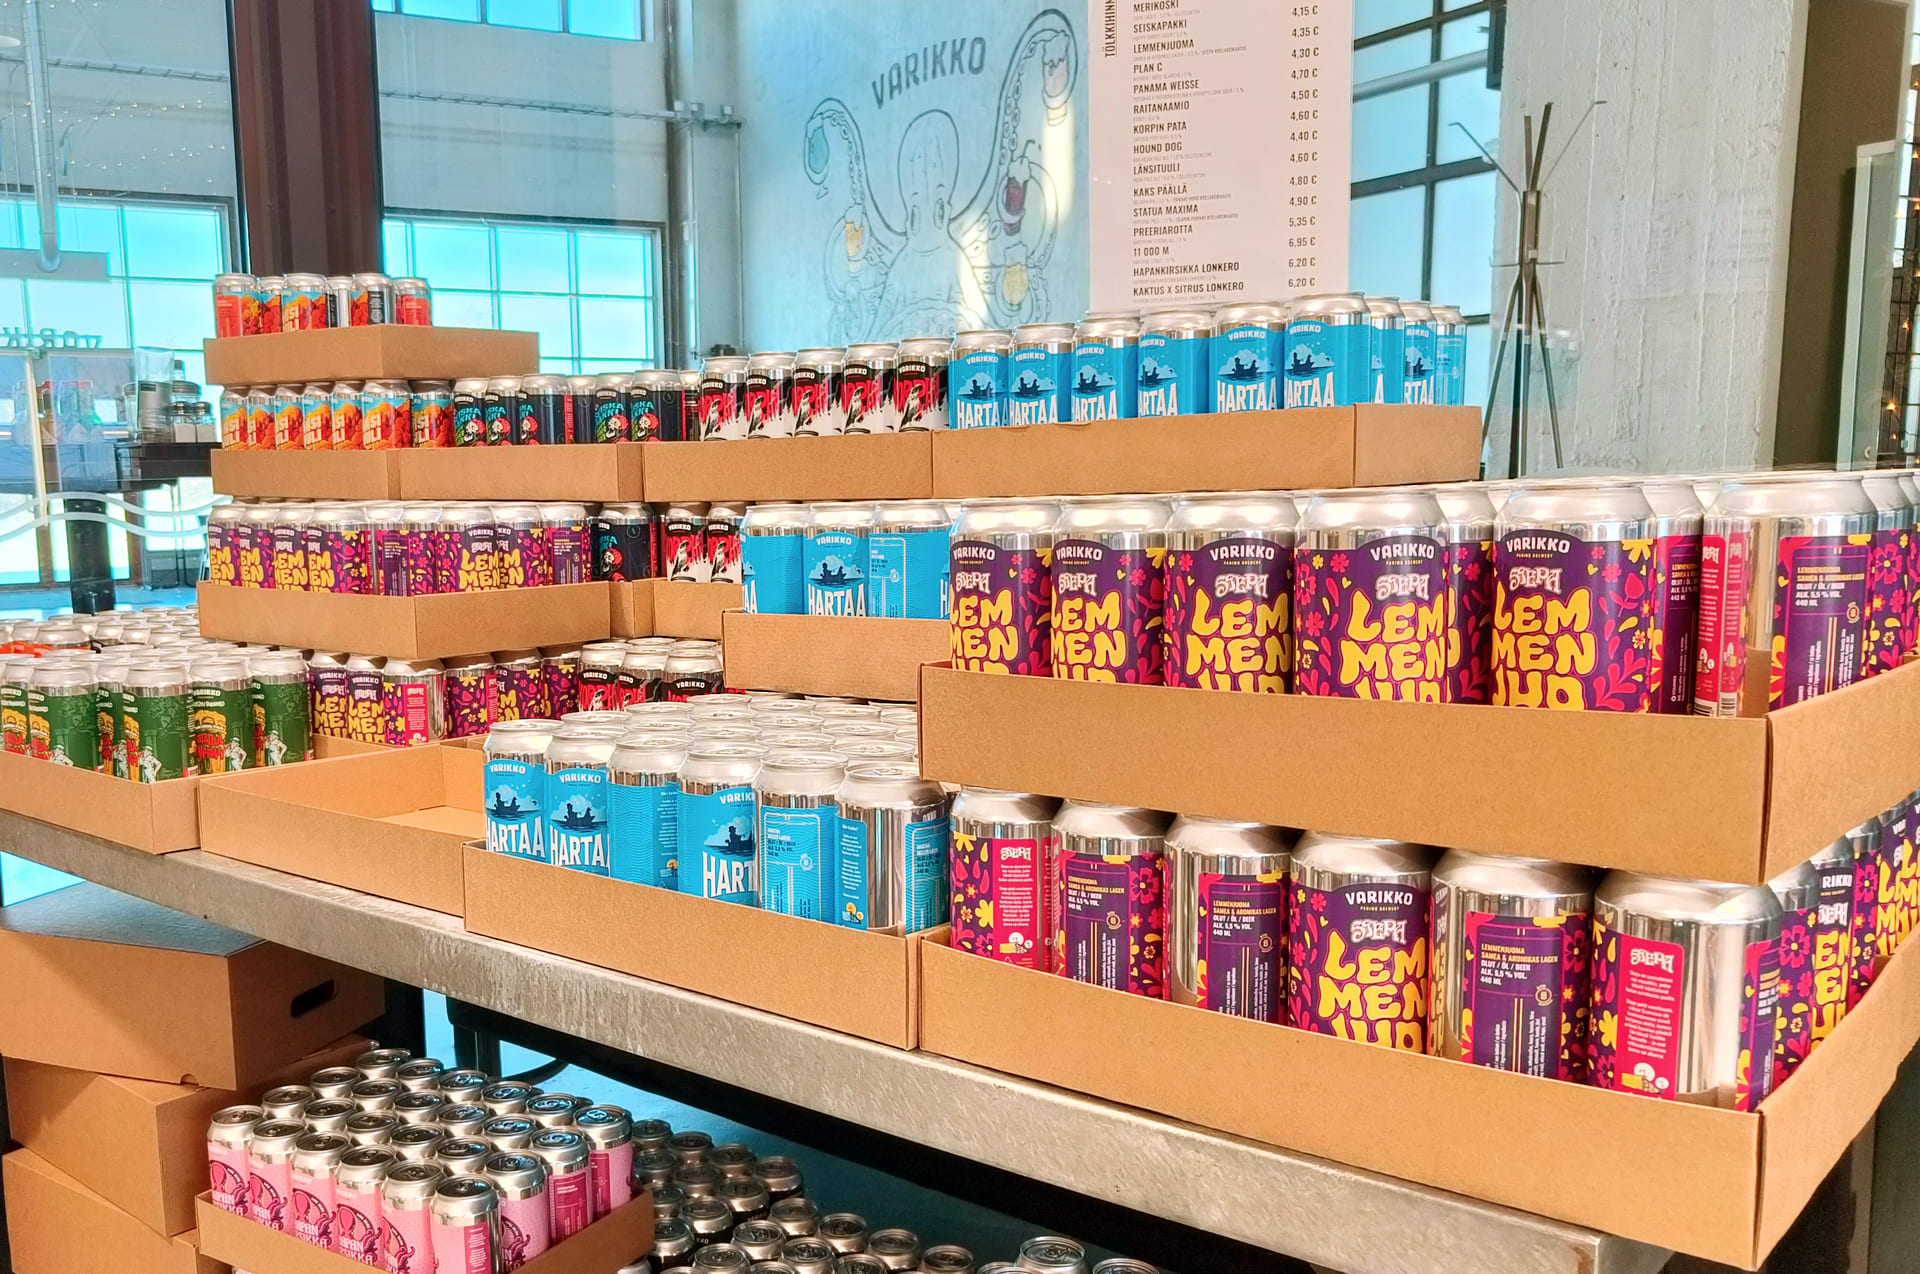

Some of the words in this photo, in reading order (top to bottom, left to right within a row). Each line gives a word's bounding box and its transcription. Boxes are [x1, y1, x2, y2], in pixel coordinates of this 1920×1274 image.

[1133, 0, 1179, 12] MERIKOSKI
[1292, 6, 1309, 17] 4,15
[1312, 6, 1318, 15] €
[1133, 19, 1187, 33] SEISKAPAKKI
[1291, 27, 1311, 38] 4,35
[1313, 26, 1319, 36] €
[1133, 39, 1194, 54] LEMMENJUOMA
[1291, 48, 1310, 59] 4,30
[1313, 47, 1319, 57] €
[872, 37, 986, 109] VARIKKO
[1133, 64, 1154, 74] PLAN
[1157, 62, 1163, 71] C
[1291, 69, 1309, 80] 4,70
[1312, 68, 1318, 78] €
[1133, 82, 1167, 95] PANAMA
[1170, 79, 1200, 91] WEISSE
[1290, 90, 1310, 101] 4,50
[1312, 89, 1318, 98] €
[1133, 100, 1190, 114] RAITANAAMIO
[1290, 111, 1310, 122] 4,60
[1312, 110, 1318, 120] €
[1133, 123, 1165, 135] KORPIN
[1168, 121, 1187, 132] PATA
[1290, 132, 1309, 142] 4,40
[1312, 130, 1318, 140] €
[1133, 144, 1162, 155] HOUND
[1165, 142, 1182, 152] DOG
[1290, 152, 1309, 163] 4,60
[1312, 152, 1318, 162] €
[1133, 162, 1180, 175] LÄNSITUULI
[1290, 176, 1309, 186] 4,80
[1311, 175, 1317, 185] €
[1133, 186, 1155, 197] KAKS
[1158, 183, 1188, 196] PÄÄLLÄ
[1289, 196, 1309, 207] 4,90
[1311, 195, 1317, 205] €
[1133, 206, 1163, 217] STATUA
[1165, 204, 1199, 215] MAXIMA
[1289, 217, 1308, 227] 5,35
[1310, 216, 1316, 226] €
[1133, 224, 1193, 237] PREERIAROTTA
[1289, 237, 1308, 248] 6,95
[1310, 237, 1316, 246] €
[1133, 248, 1141, 257] 11
[1144, 247, 1160, 256] 000
[1162, 246, 1170, 255] M
[1133, 264, 1200, 277] HAPANKIRSIKKA
[1202, 262, 1240, 273] LONKERO
[1288, 258, 1308, 269] 6,20
[1310, 257, 1316, 267] €
[1133, 286, 1165, 296] KAKTUS
[1167, 285, 1173, 294] X
[1174, 284, 1204, 294] SITRUS
[1206, 281, 1244, 292] LONKERO
[1288, 278, 1308, 289] 6,20
[1309, 277, 1315, 287] €
[1228, 331, 1266, 342] VARIKKO
[1217, 376, 1277, 413] HARTAA
[816, 536, 852, 546] VARIKKO
[1506, 536, 1570, 554] VARIKKO
[953, 546, 996, 561] VARIKKO
[1056, 546, 1102, 561] VARIKKO
[1210, 544, 1275, 560] VARIKKO
[1370, 543, 1435, 561] VARIKKO
[808, 583, 866, 617] HARTAA
[1191, 588, 1289, 638] LEM
[1494, 581, 1592, 636] LEM
[1348, 590, 1445, 643] LEM
[1186, 634, 1292, 675] MEN
[1492, 628, 1597, 676] MEN
[1340, 637, 1446, 685] MEN
[676, 680, 705, 689] VARIKKO
[490, 764, 526, 775] VARIKKO
[560, 773, 602, 784] VARIKKO
[720, 792, 755, 805] VARIK
[550, 825, 610, 867] HARTA
[1345, 890, 1413, 906] VARIKKO
[1325, 931, 1426, 984] LEM
[1318, 975, 1427, 1020] MEN
